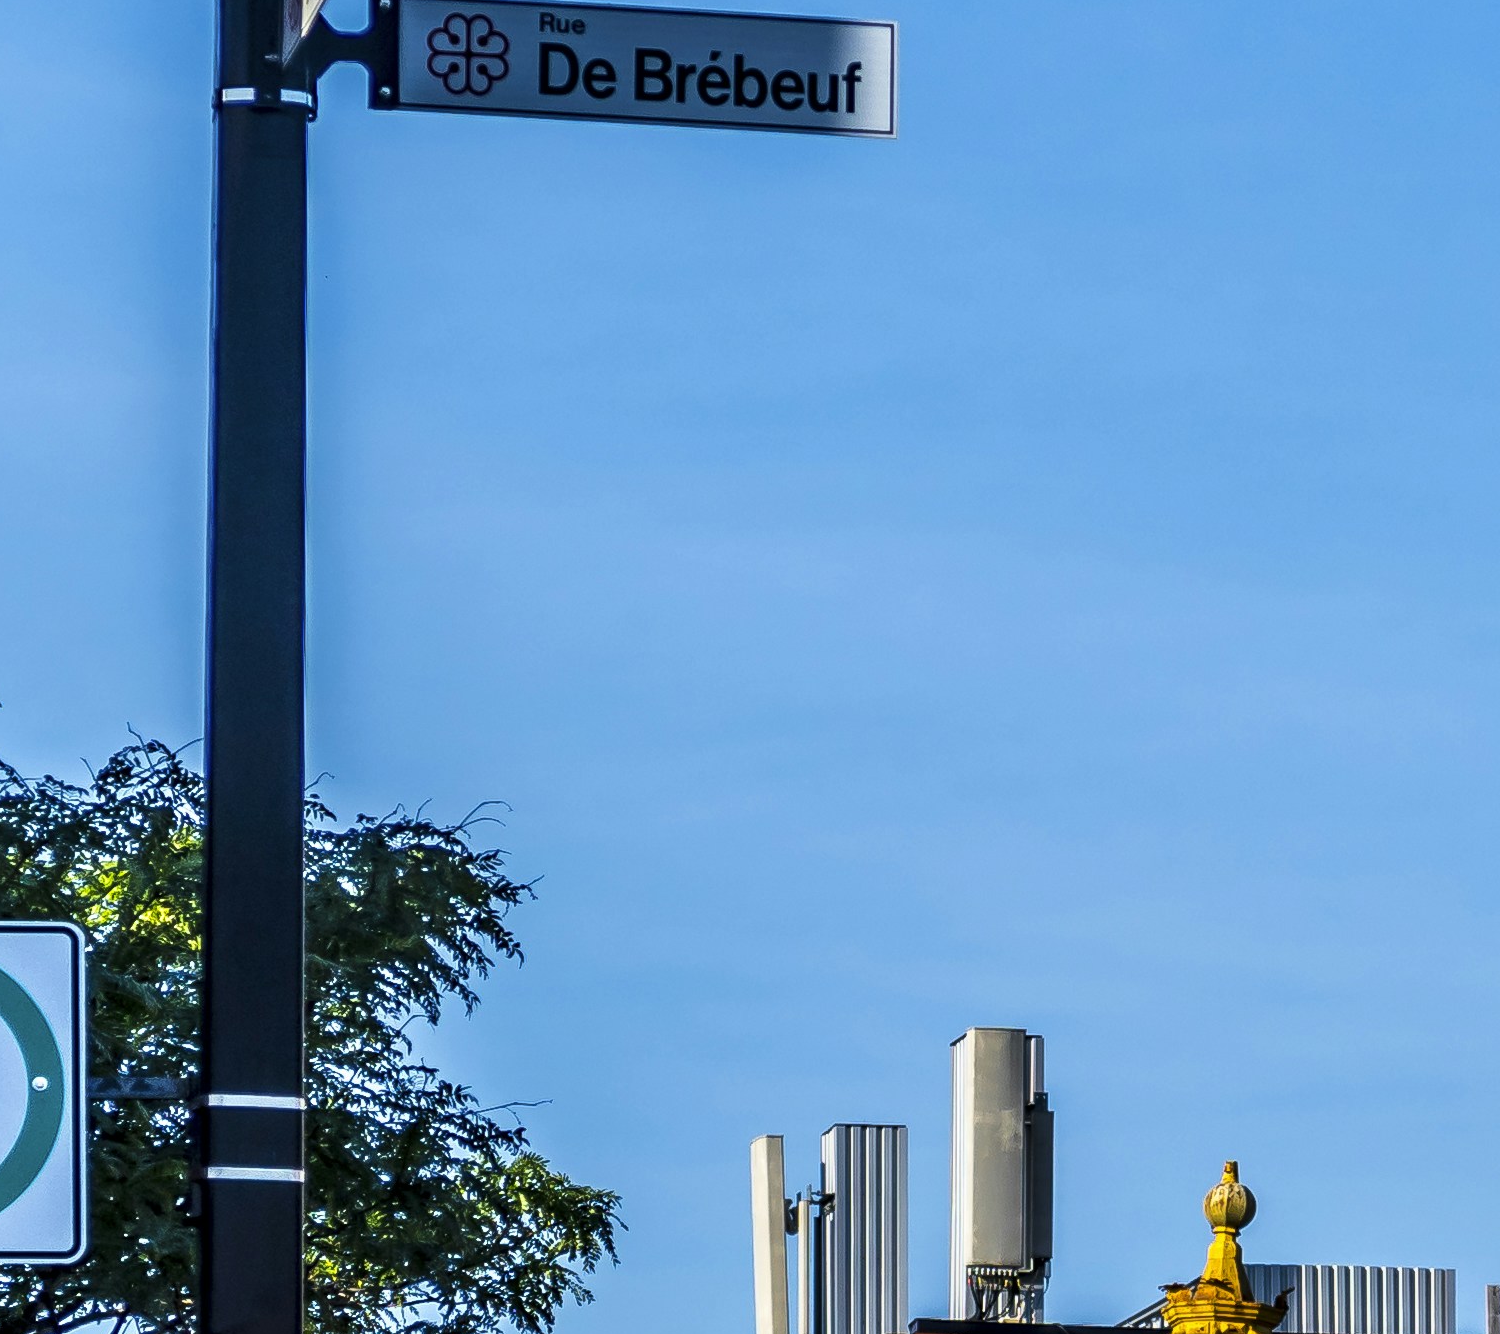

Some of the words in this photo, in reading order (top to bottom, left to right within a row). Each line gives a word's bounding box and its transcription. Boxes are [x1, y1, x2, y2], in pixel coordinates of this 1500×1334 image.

[538, 11, 587, 35] Rue
[537, 41, 618, 100] De
[632, 47, 863, 114] Brébeuf
